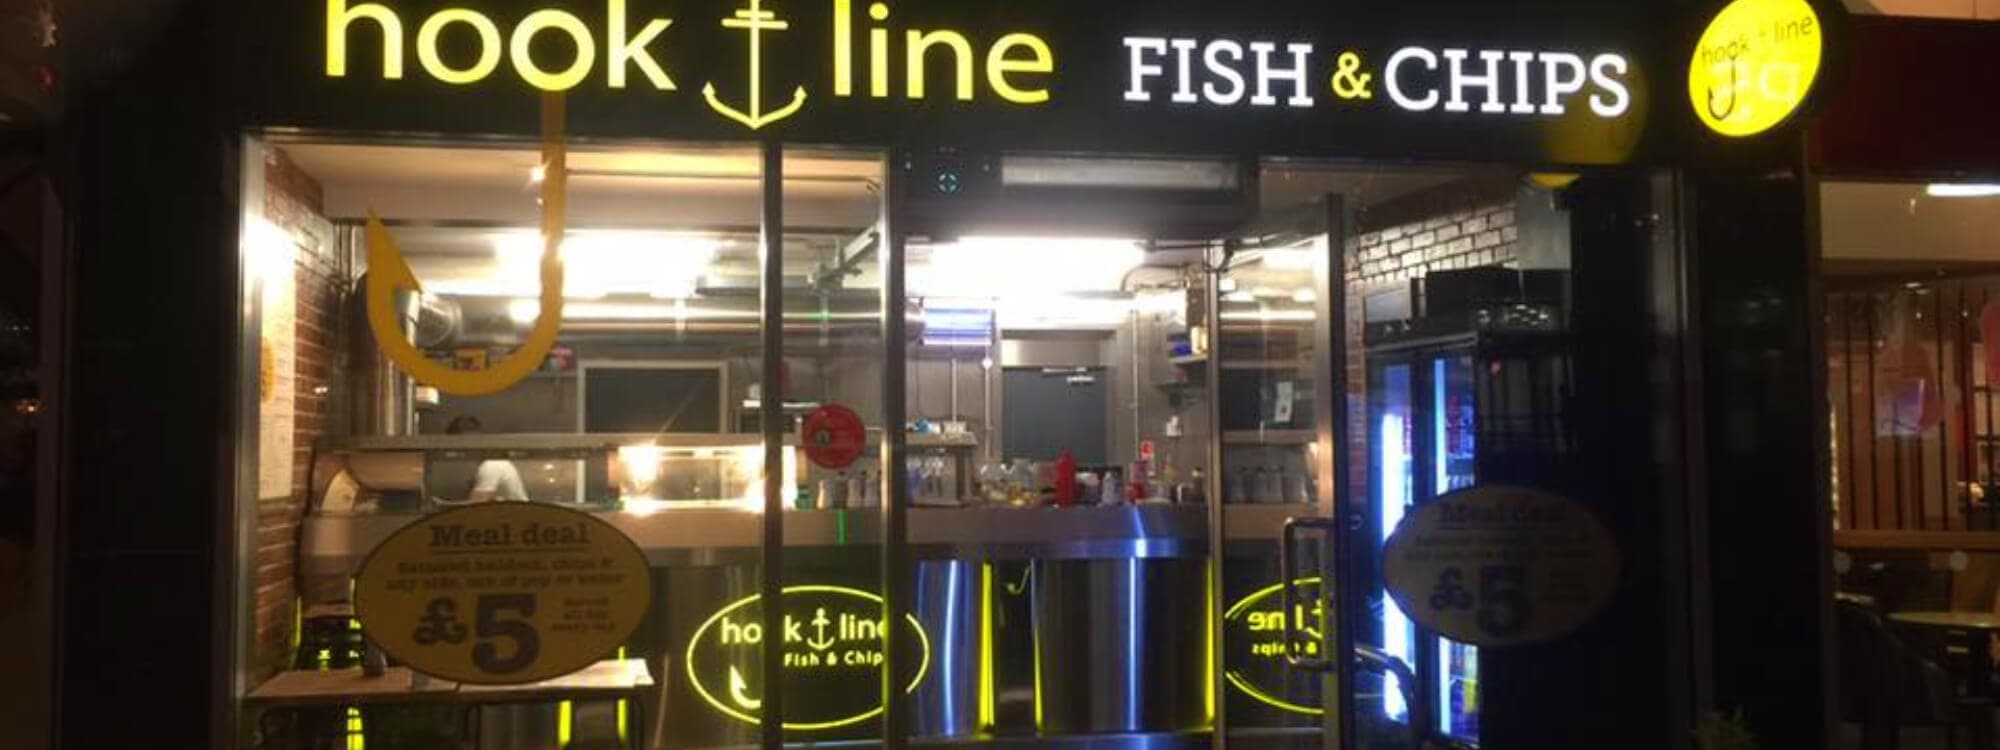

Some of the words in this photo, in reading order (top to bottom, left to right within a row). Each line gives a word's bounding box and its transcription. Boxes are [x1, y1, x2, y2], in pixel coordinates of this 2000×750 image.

[326, 0, 677, 91] hook
[833, 0, 1054, 104] line
[1701, 33, 1751, 67] hook
[1774, 16, 1813, 43] line
[1123, 36, 1314, 107] FISH
[1331, 51, 1372, 99] &
[1384, 46, 1631, 118] CHIPS
[430, 523, 511, 547] Meal
[521, 522, 592, 545] deal
[721, 615, 803, 644] hok
[1429, 565, 1532, 635] £5
[411, 592, 541, 675] £5
[784, 652, 820, 667] Fish
[826, 652, 837, 665] &
